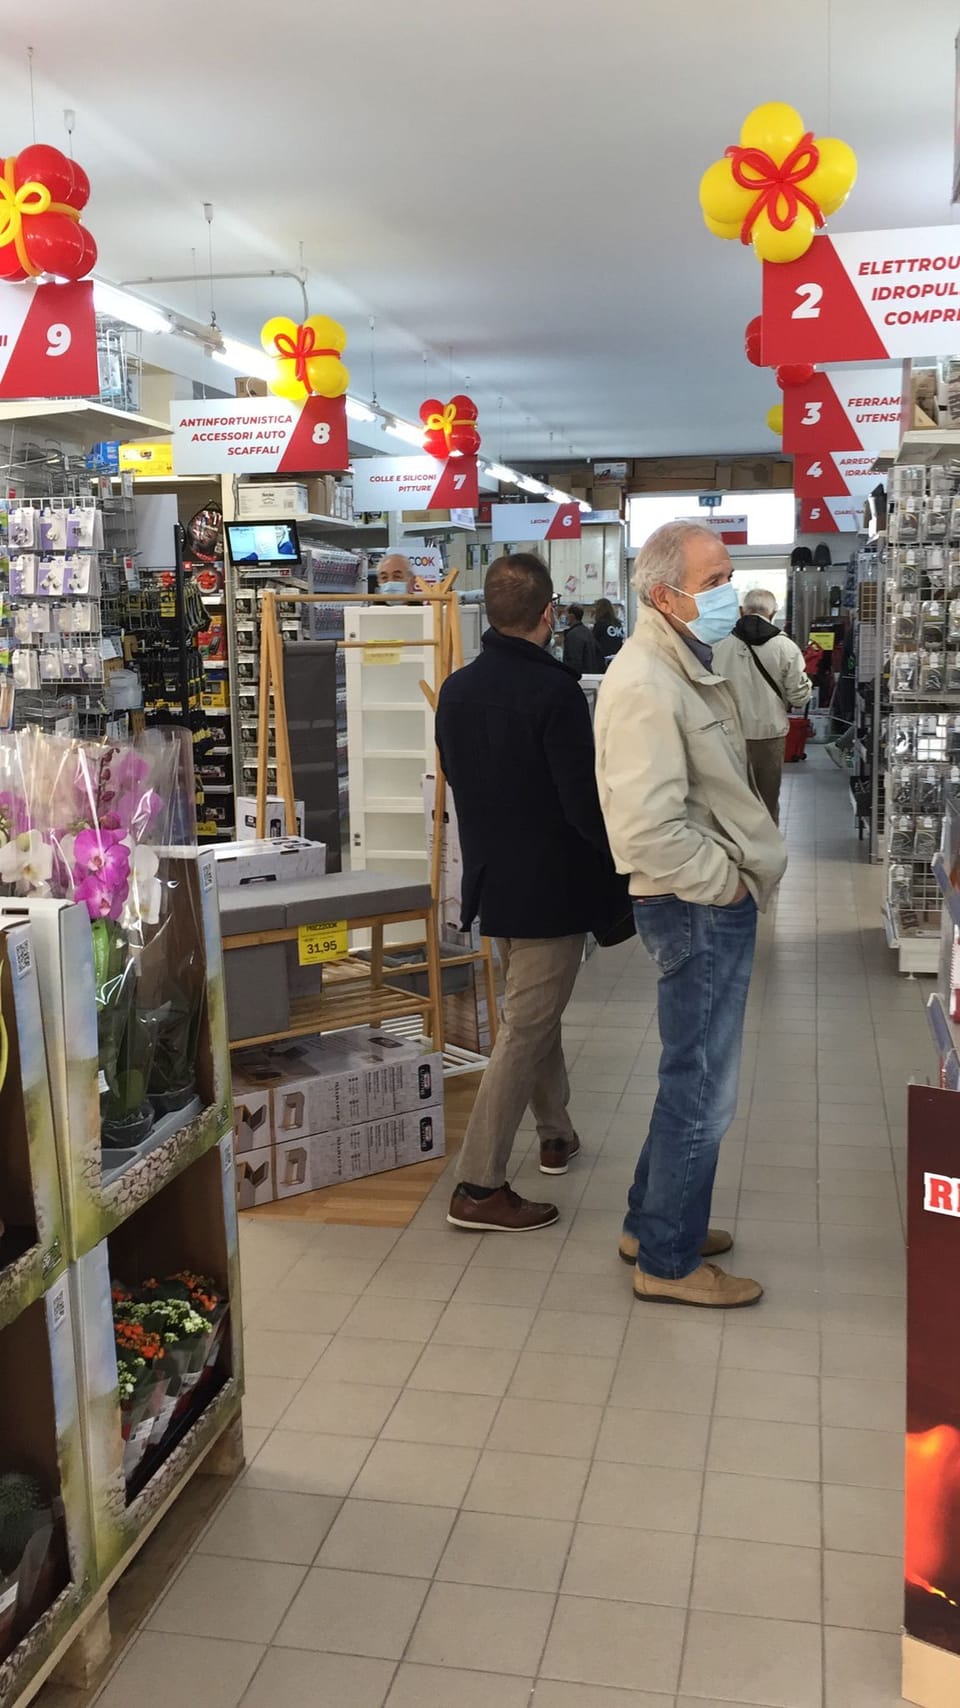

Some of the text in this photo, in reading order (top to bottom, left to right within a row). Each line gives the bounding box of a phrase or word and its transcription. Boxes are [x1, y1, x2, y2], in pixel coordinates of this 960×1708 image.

[858, 256, 960, 276] ELETTROU
[791, 283, 823, 319] 2
[46, 323, 71, 356] 9
[847, 397, 902, 407] FERRAM
[801, 402, 822, 425] 3
[179, 415, 292, 427] ANTINFORTUNISTICA
[192, 430, 286, 442] ACCESSORI AUTO
[311, 423, 331, 445] 8
[227, 446, 280, 456] SCAFFALI
[806, 461, 823, 478] 4
[370, 475, 394, 483] COLLE
[403, 474, 436, 482] SILICONI
[453, 474, 467, 490] 7
[398, 485, 432, 493] PITTURE
[810, 508, 821, 519] 5
[562, 515, 573, 527] 6
[408, 556, 435, 567] COOK
[929, 1177, 960, 1212] R
